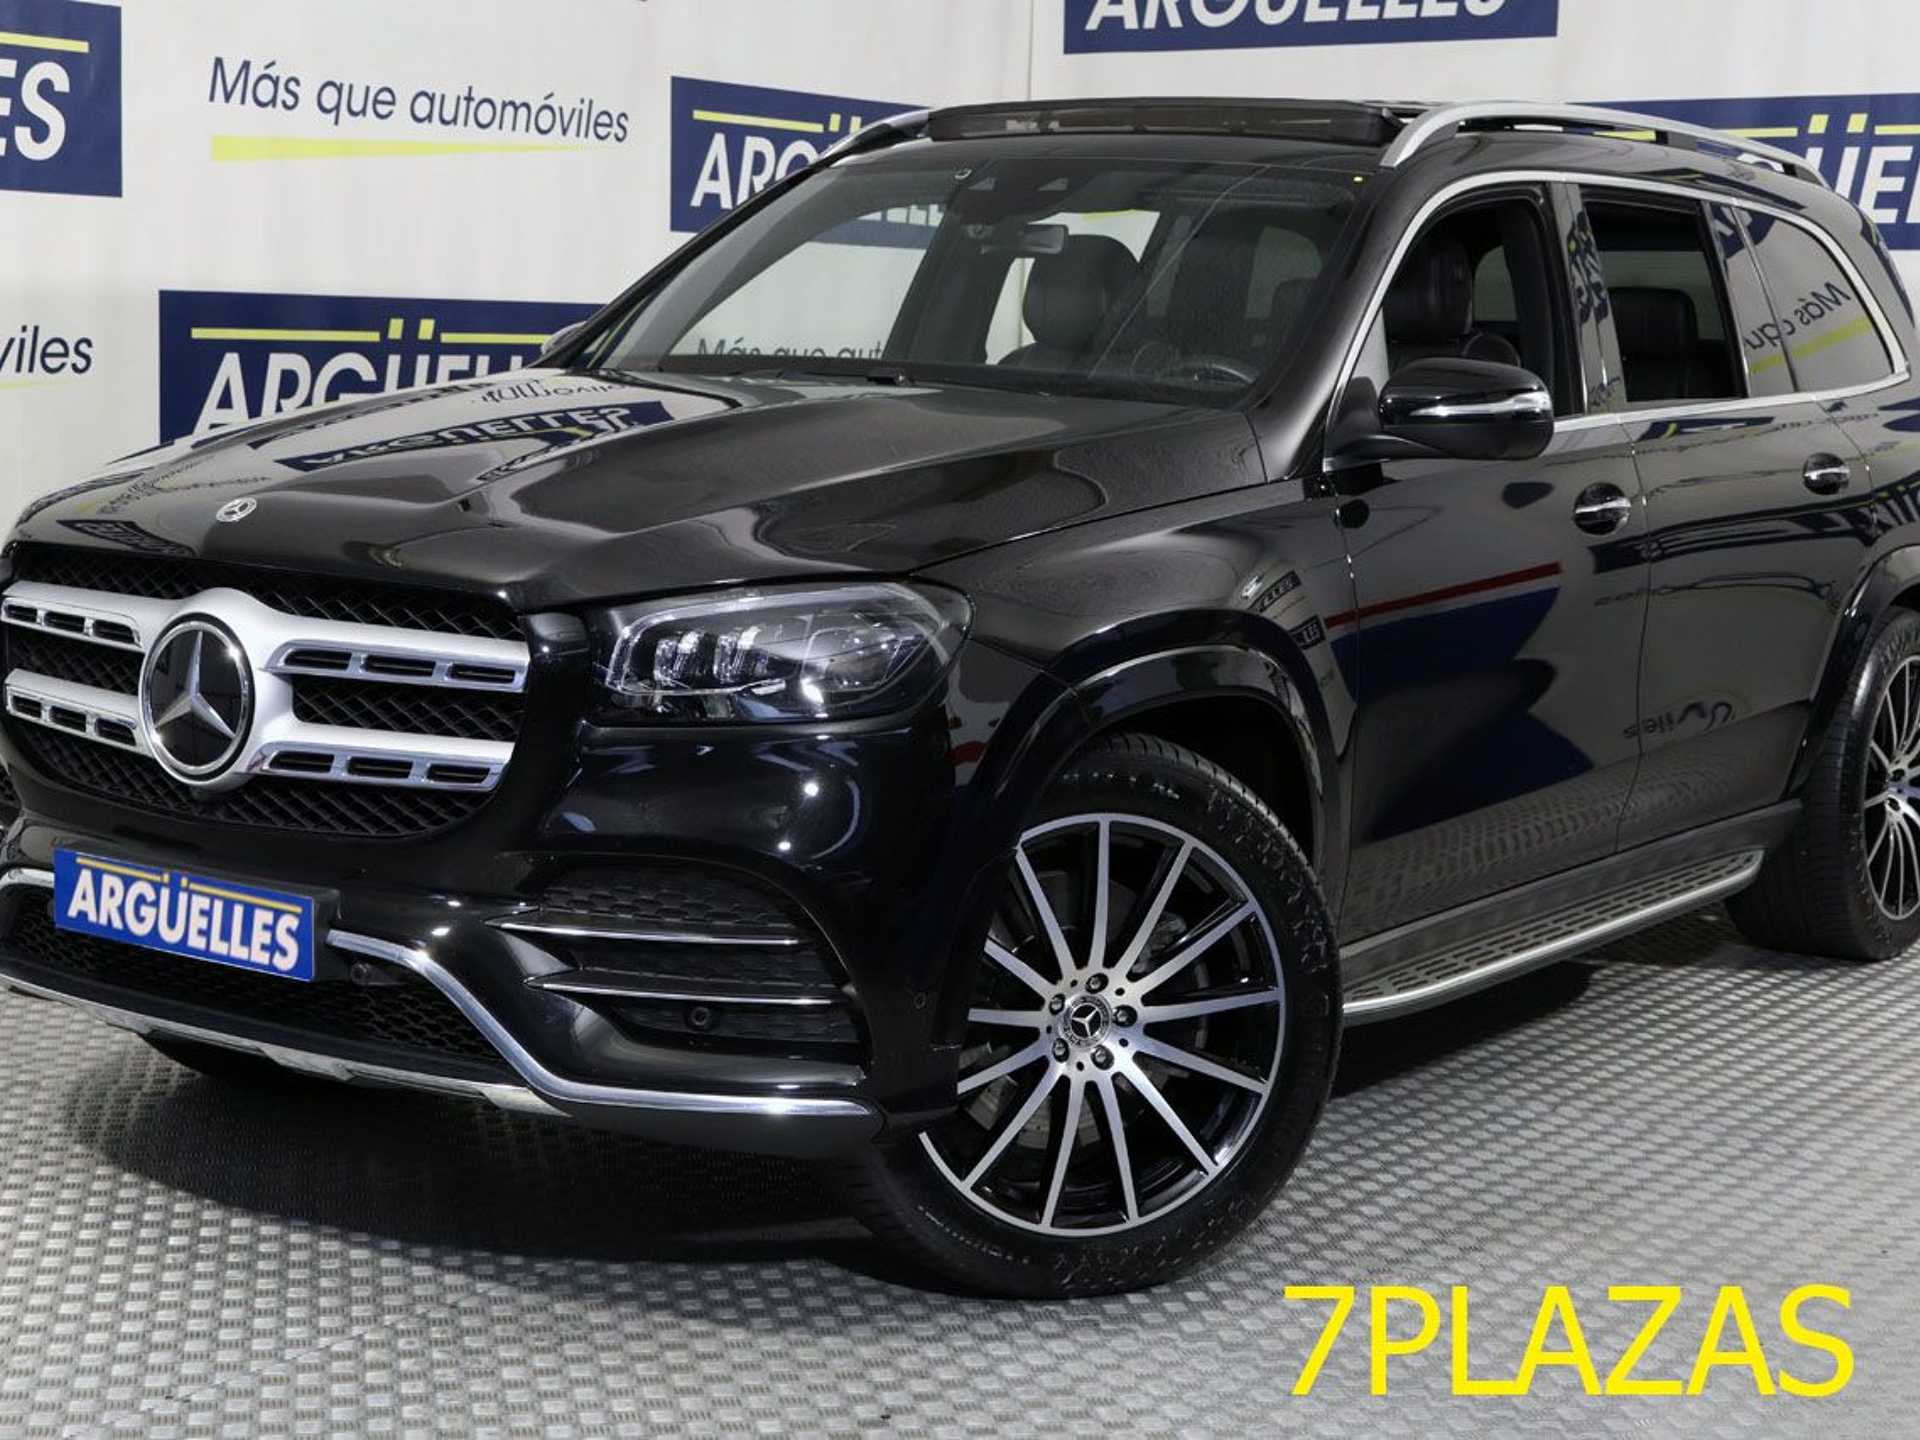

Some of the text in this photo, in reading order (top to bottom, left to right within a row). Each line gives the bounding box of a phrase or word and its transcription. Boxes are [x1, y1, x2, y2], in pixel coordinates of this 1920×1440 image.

[208, 56, 629, 143] Más que automóviles
[67, 864, 301, 972] ARGÜELLES
